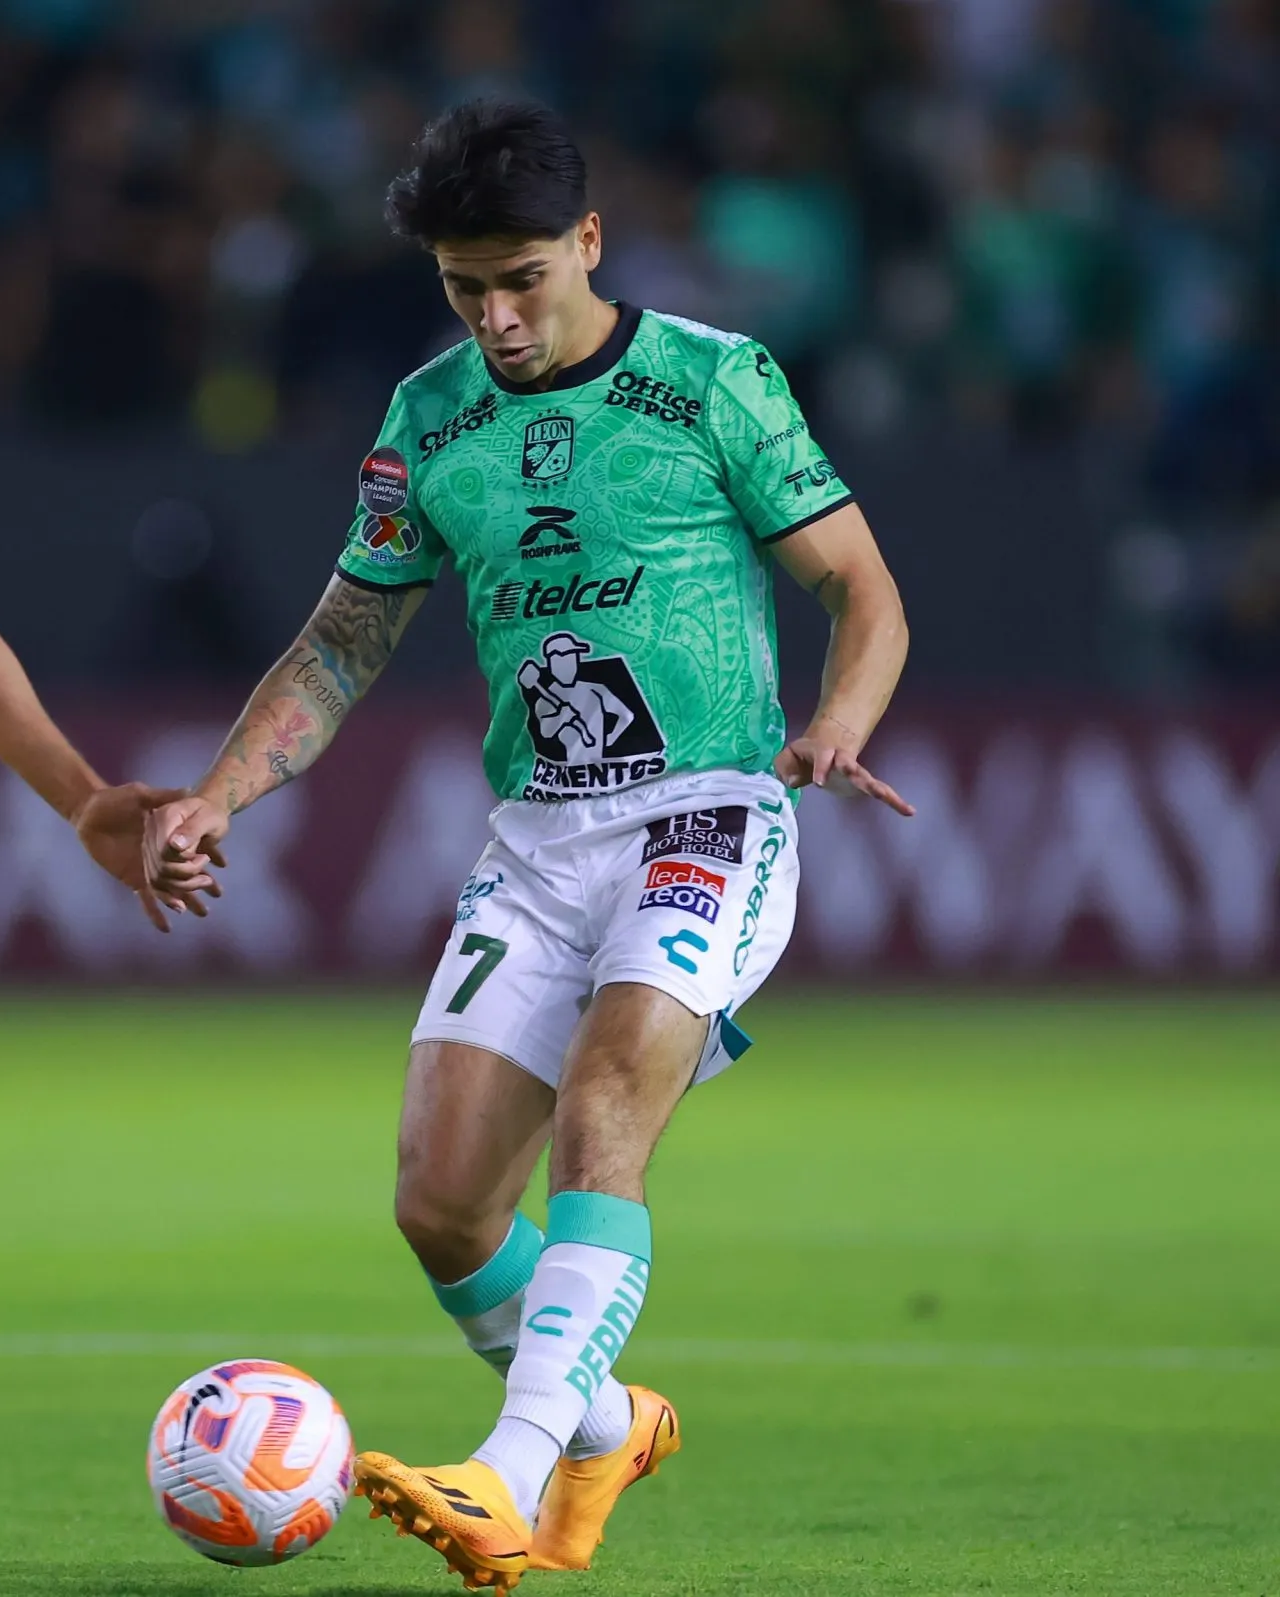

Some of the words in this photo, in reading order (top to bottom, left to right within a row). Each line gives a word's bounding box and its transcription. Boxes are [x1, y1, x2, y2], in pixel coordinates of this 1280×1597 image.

[612, 370, 702, 416] Office
[604, 389, 697, 428] DEPOT
[530, 421, 570, 441] LEON
[371, 460, 402, 475] Scotiabank
[361, 481, 406, 498] CHAMPIONS
[523, 565, 645, 619] telcel
[533, 757, 667, 788] CEMENTOS
[664, 809, 718, 838] HS
[646, 831, 738, 858] HOTSSON
[681, 844, 735, 861] HOTEL
[649, 866, 721, 894] leche
[444, 932, 510, 1016] 7
